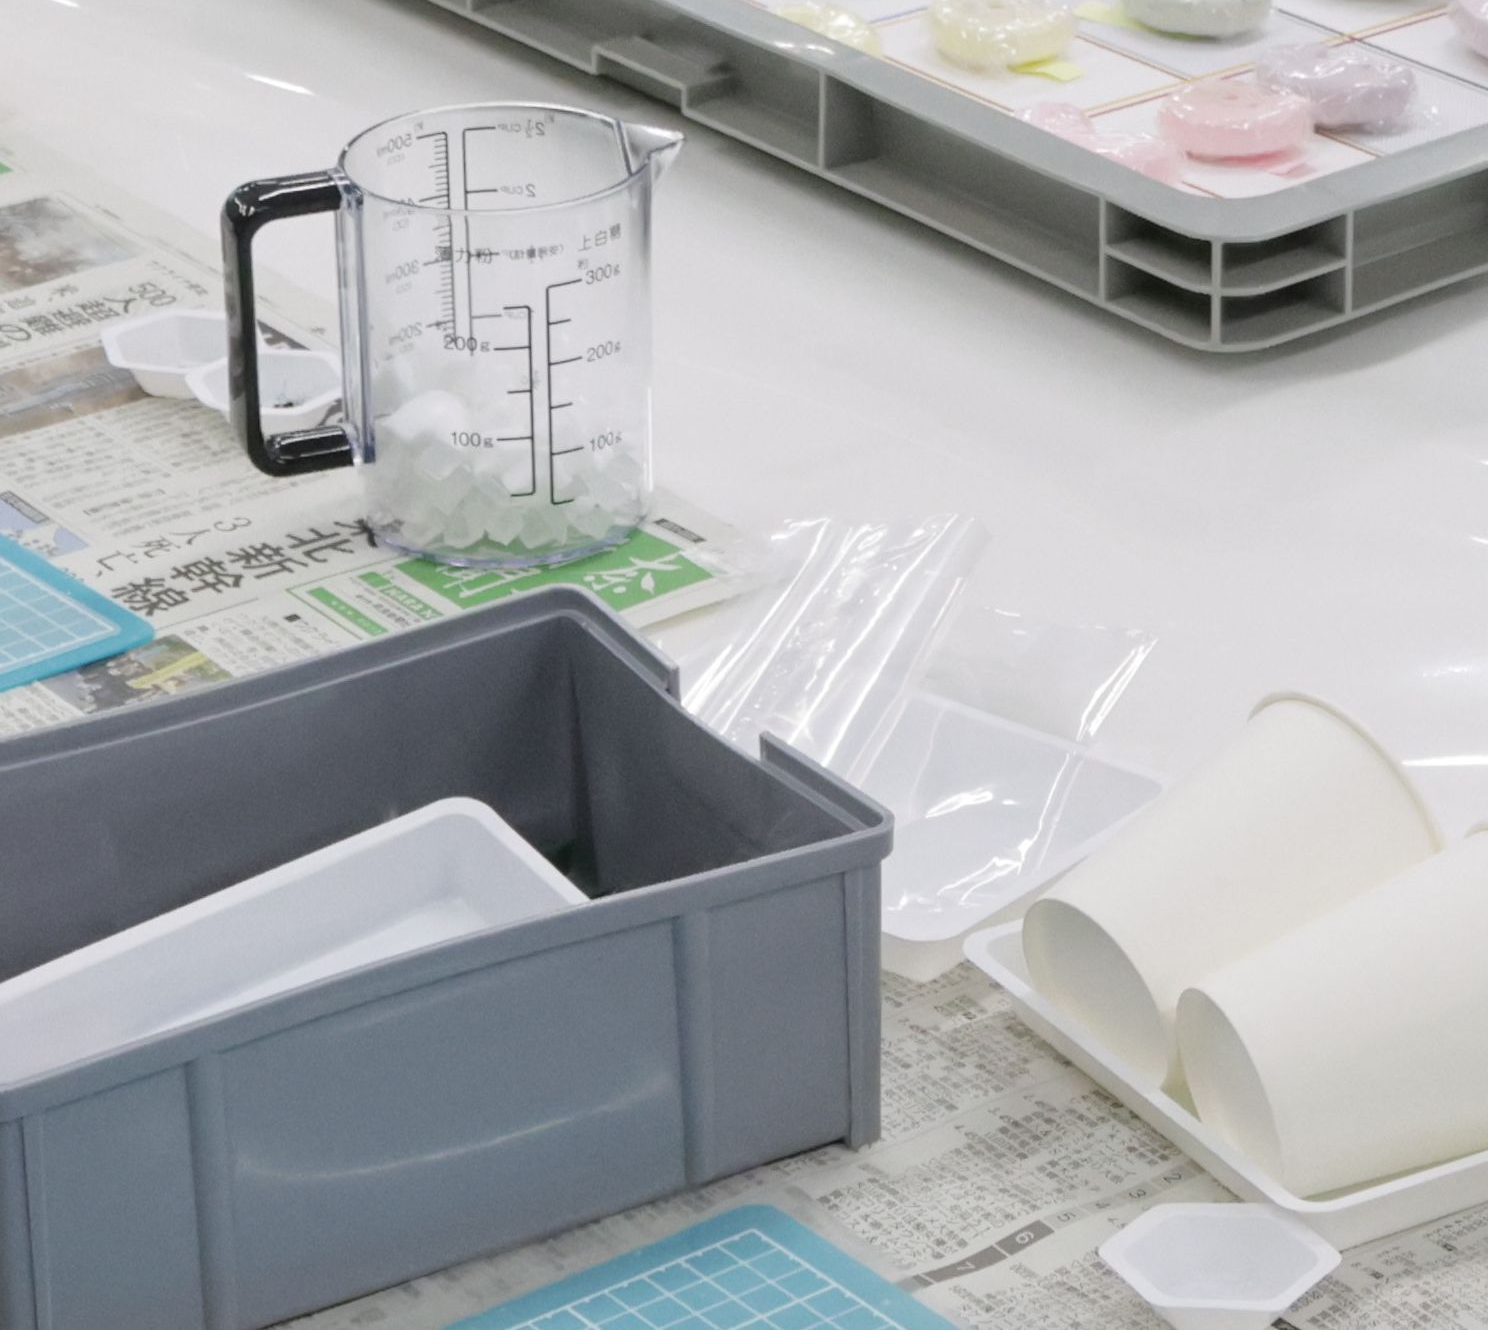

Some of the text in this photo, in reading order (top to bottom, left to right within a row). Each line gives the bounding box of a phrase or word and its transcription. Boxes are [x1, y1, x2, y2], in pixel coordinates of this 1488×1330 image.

[585, 264, 622, 285] 300g
[443, 336, 491, 353] 200g
[587, 341, 622, 362] 200g
[451, 431, 494, 449] 100g
[589, 432, 623, 453] 100g
